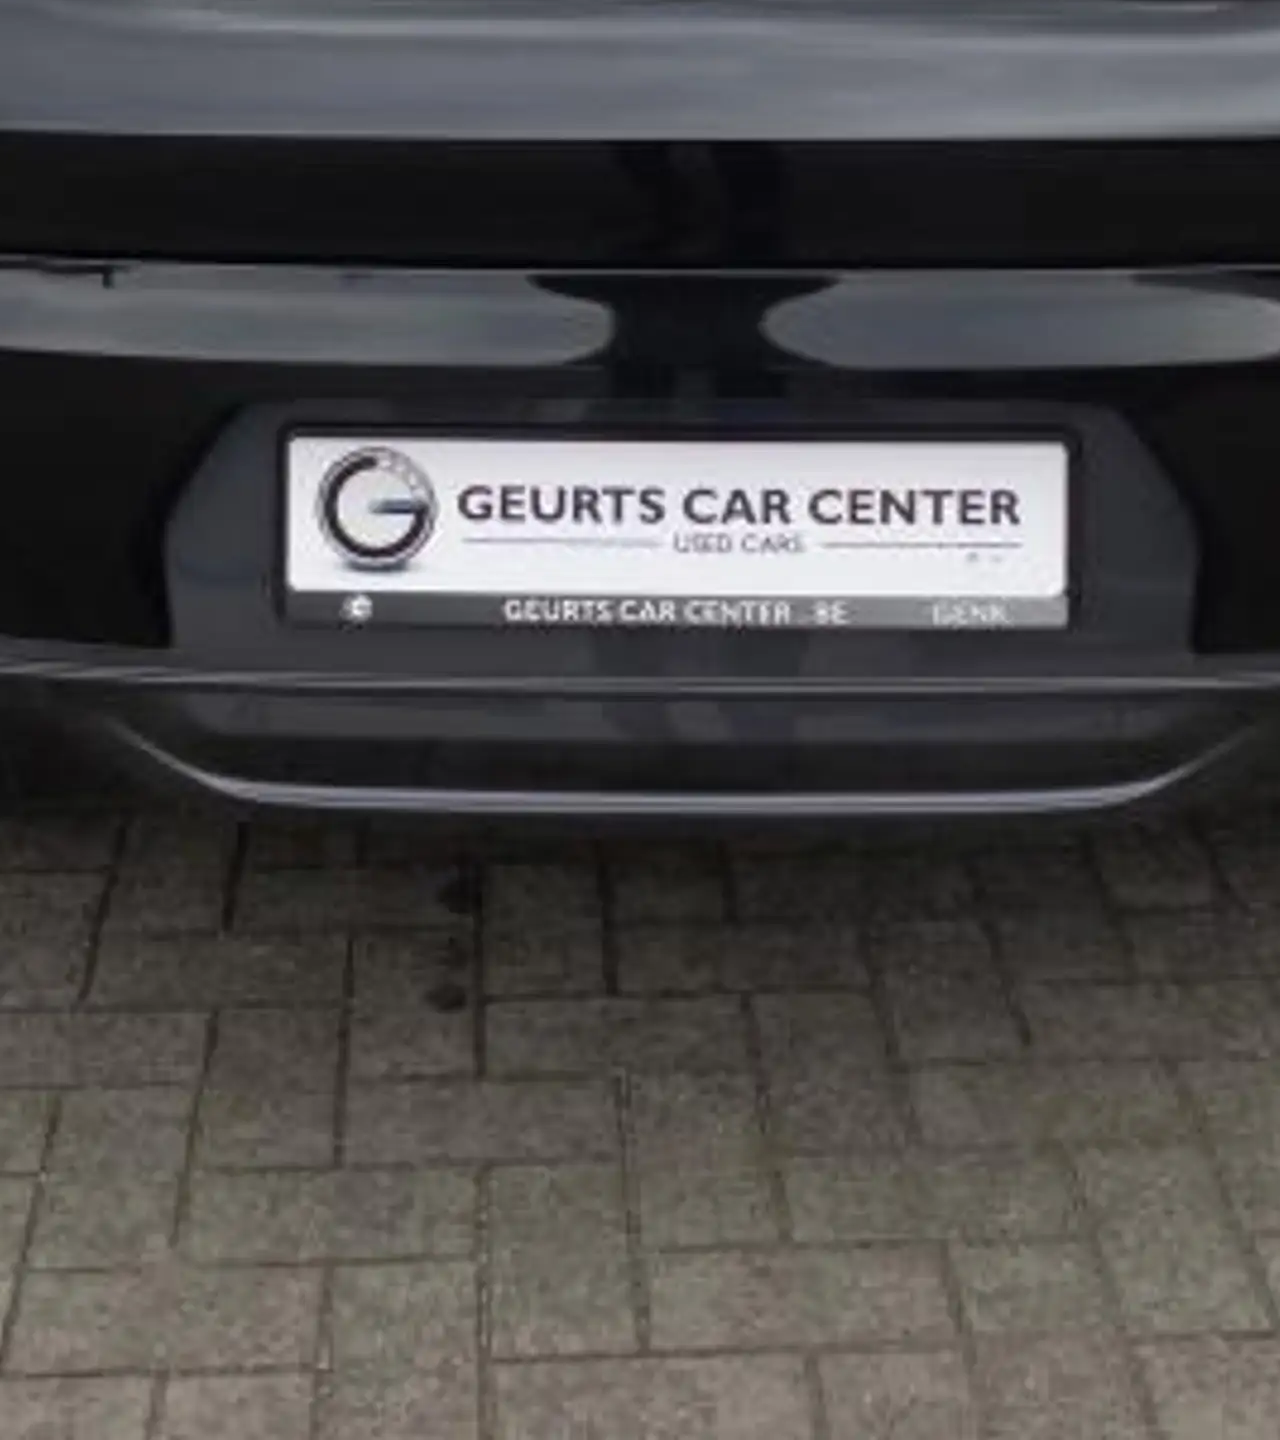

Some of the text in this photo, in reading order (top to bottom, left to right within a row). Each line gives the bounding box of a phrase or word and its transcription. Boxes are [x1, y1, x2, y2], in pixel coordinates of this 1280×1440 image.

[456, 484, 1022, 527] GEURTS CAR CENTER
[673, 531, 806, 555] USED CARS
[503, 598, 614, 623] GEURTS
[620, 599, 677, 623] CAR
[683, 599, 793, 625] CENTER
